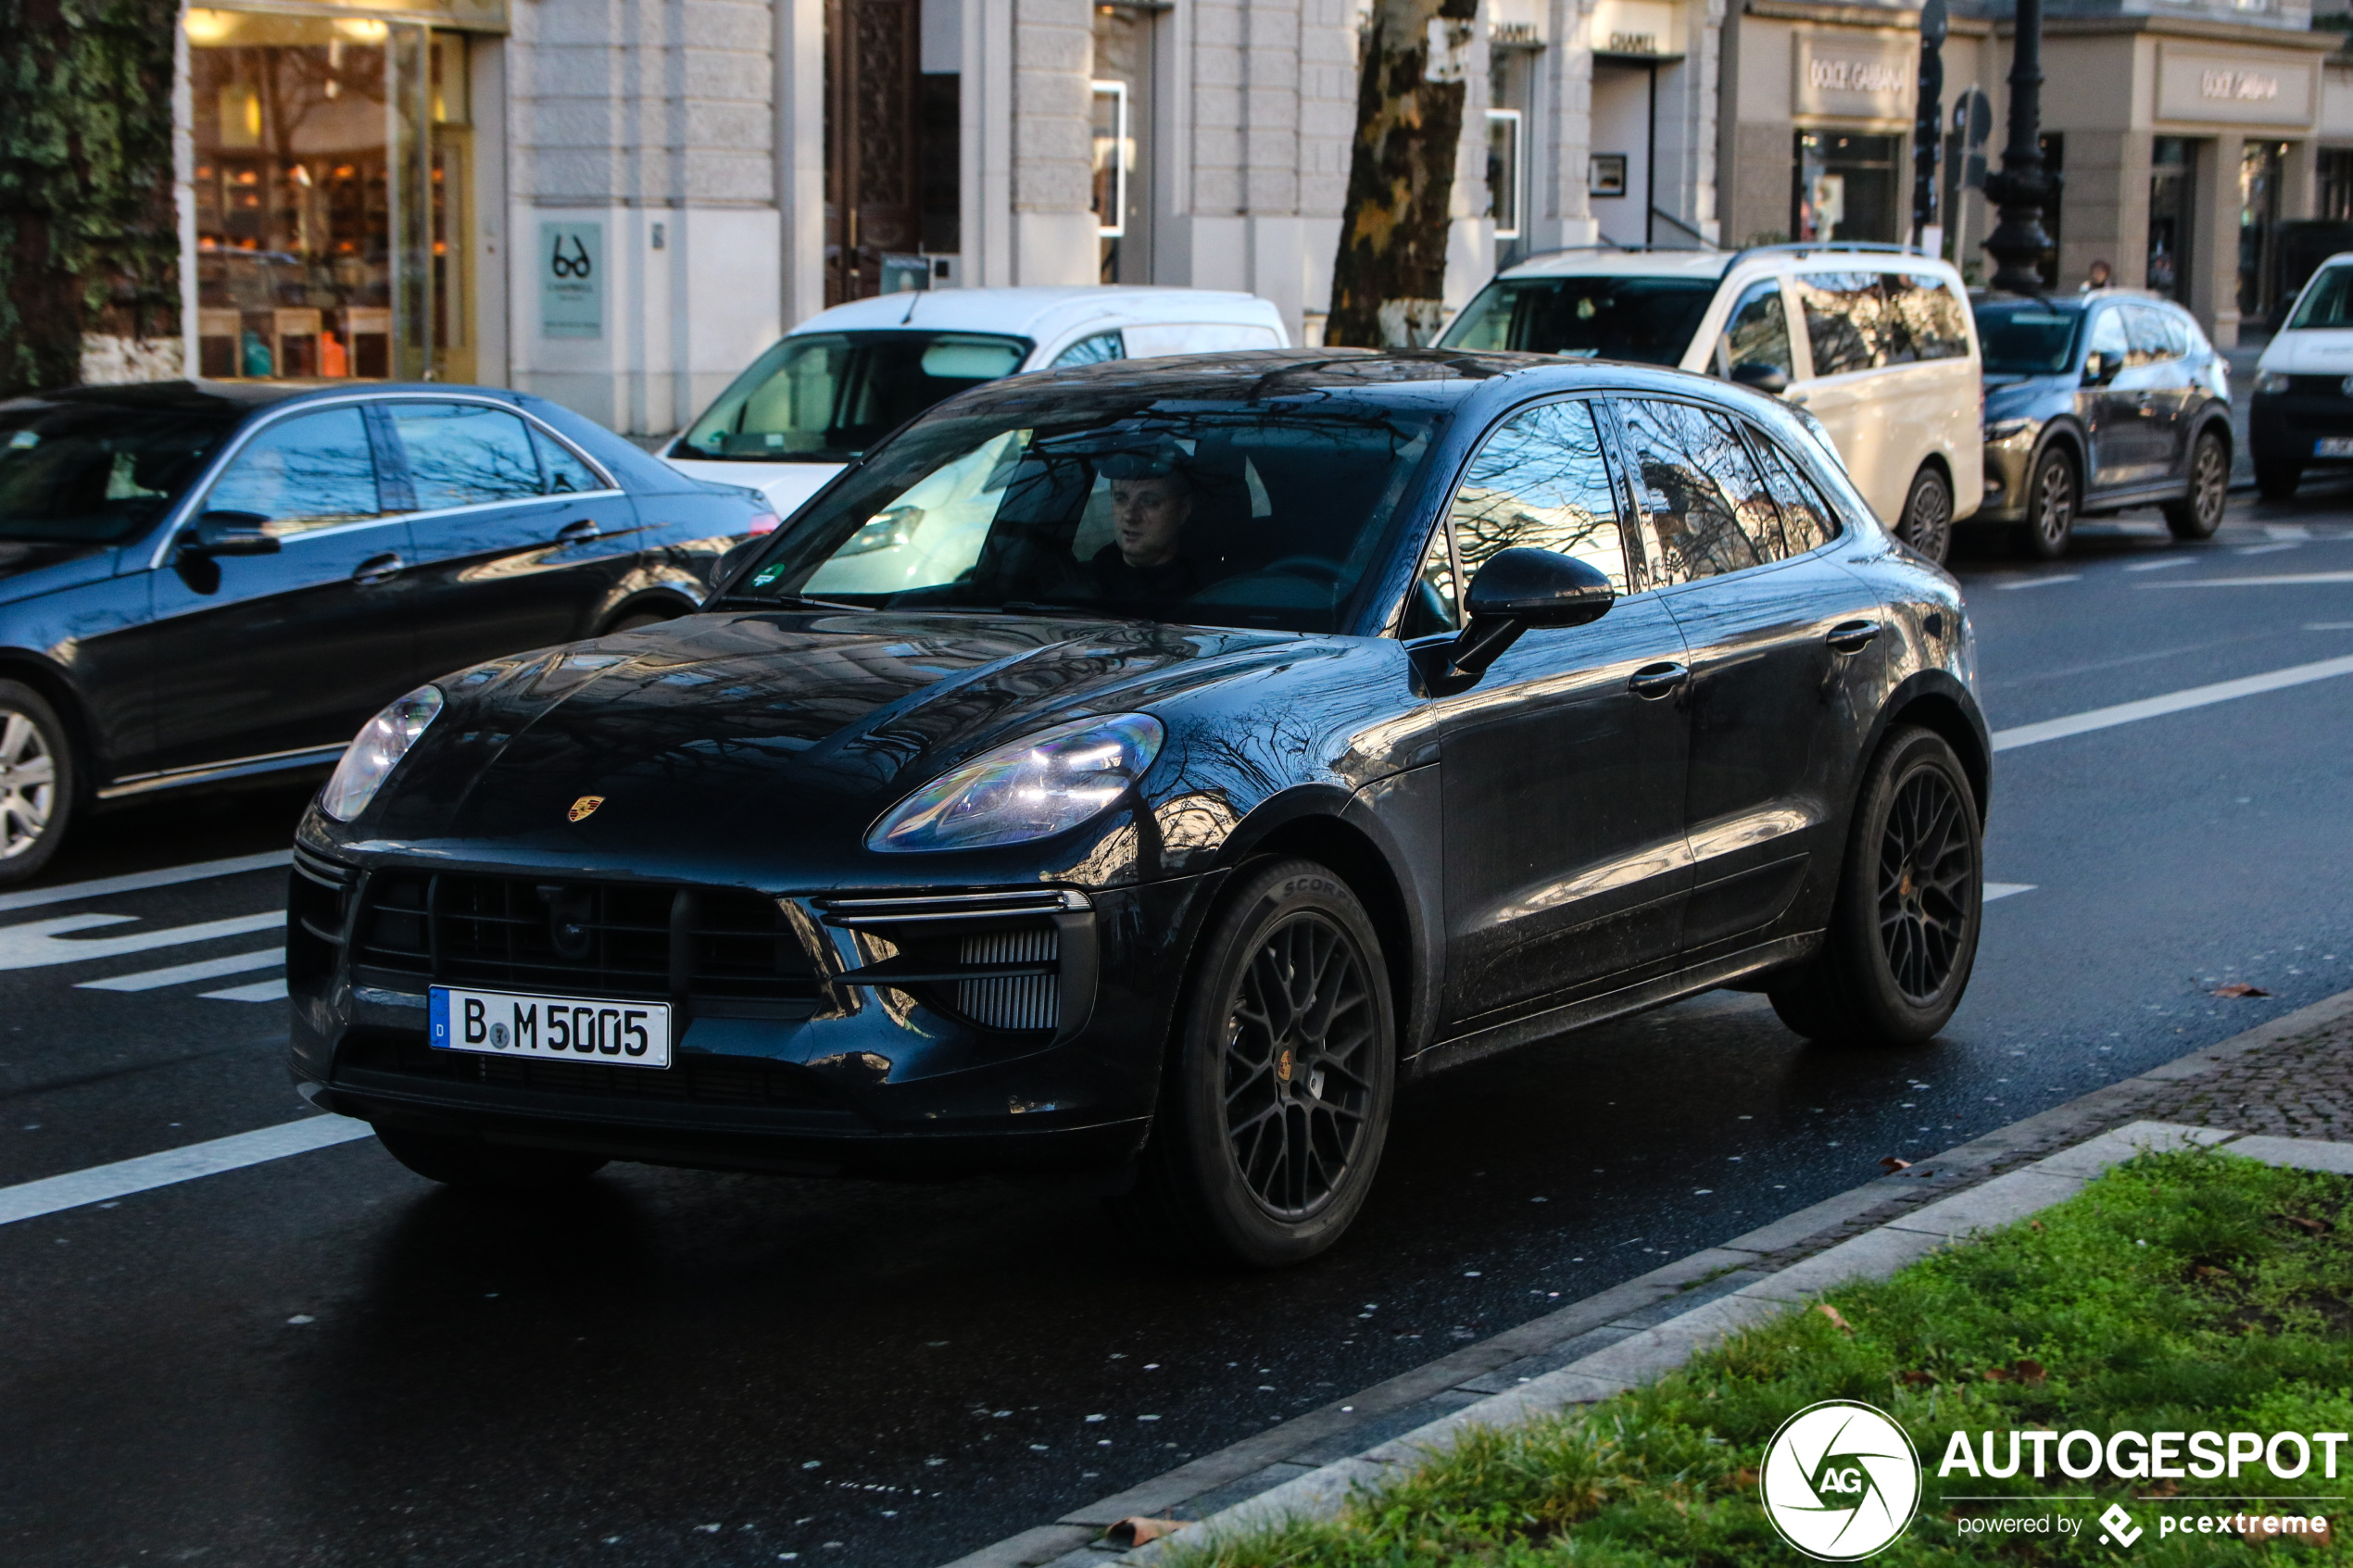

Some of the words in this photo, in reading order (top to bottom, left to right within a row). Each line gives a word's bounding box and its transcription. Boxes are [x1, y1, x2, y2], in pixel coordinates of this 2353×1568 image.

[1610, 31, 1657, 53] CHANEL
[436, 1023, 444, 1037] D
[464, 997, 487, 1043] B
